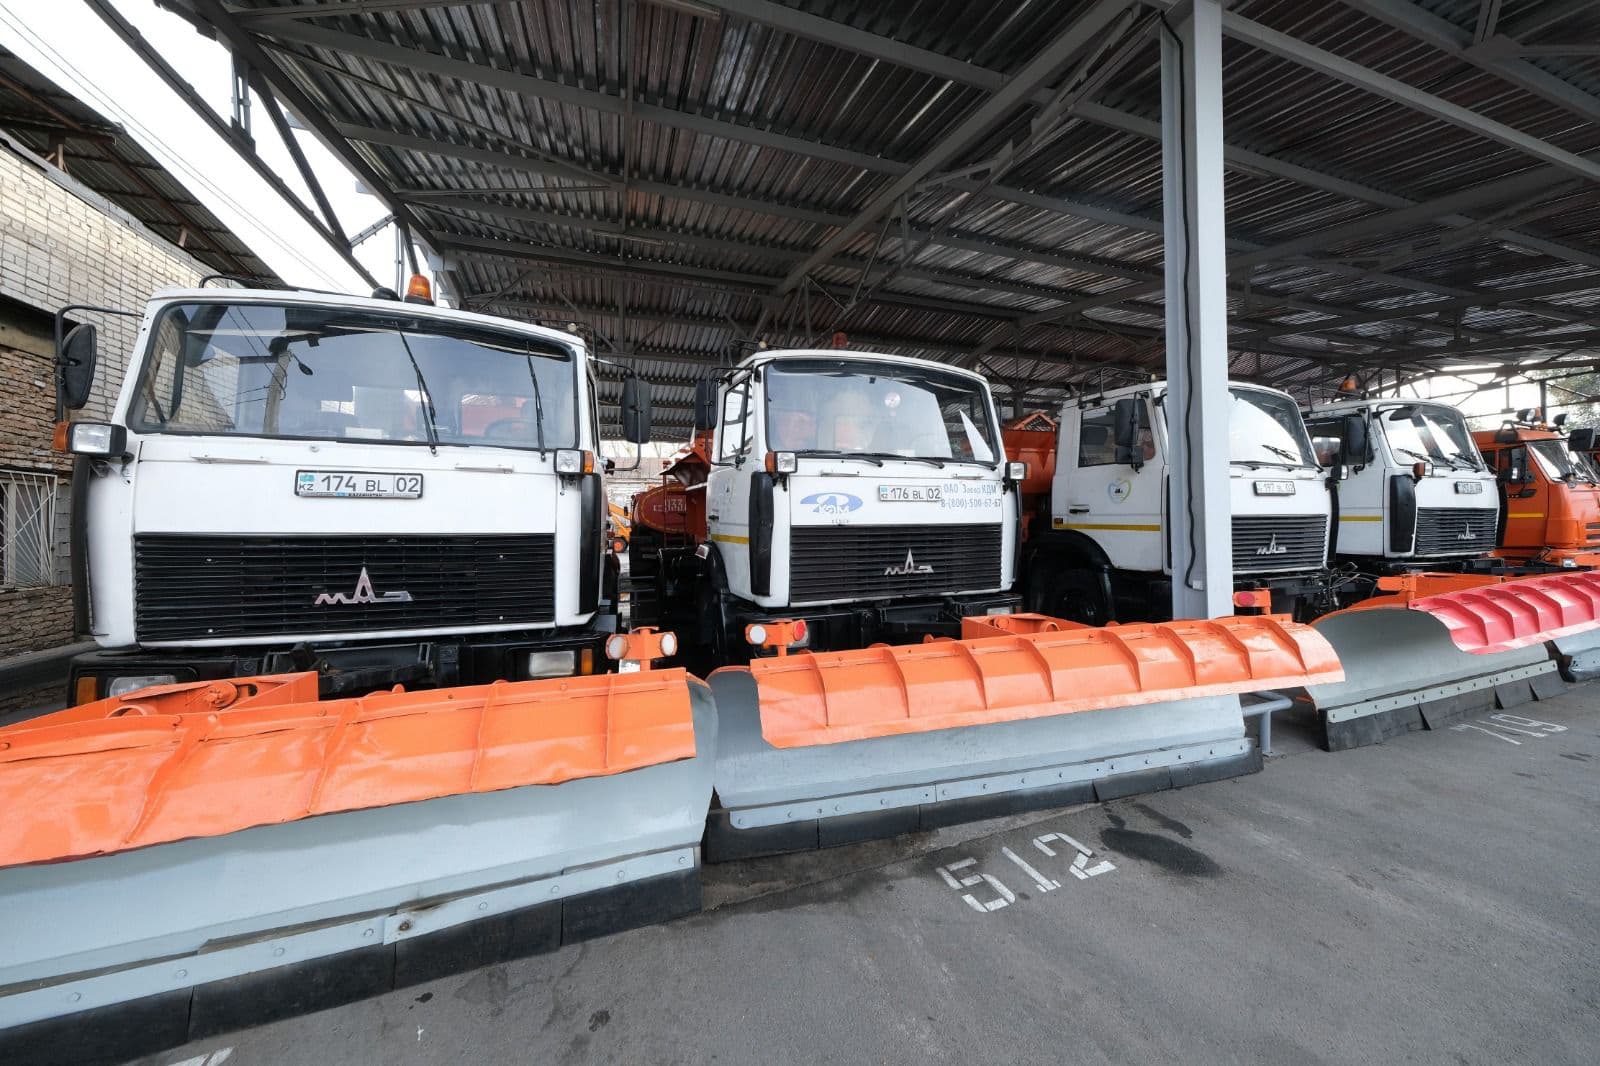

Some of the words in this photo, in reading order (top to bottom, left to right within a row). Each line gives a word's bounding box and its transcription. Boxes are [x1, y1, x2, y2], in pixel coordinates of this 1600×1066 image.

[299, 483, 314, 491] KZ
[321, 475, 357, 491] 174
[365, 479, 387, 492] BL
[396, 477, 419, 492] 02
[891, 487, 909, 499] 176
[912, 490, 924, 499] BL
[927, 487, 940, 499] 02
[1449, 703, 1569, 746] 719
[936, 832, 1117, 912] 512
